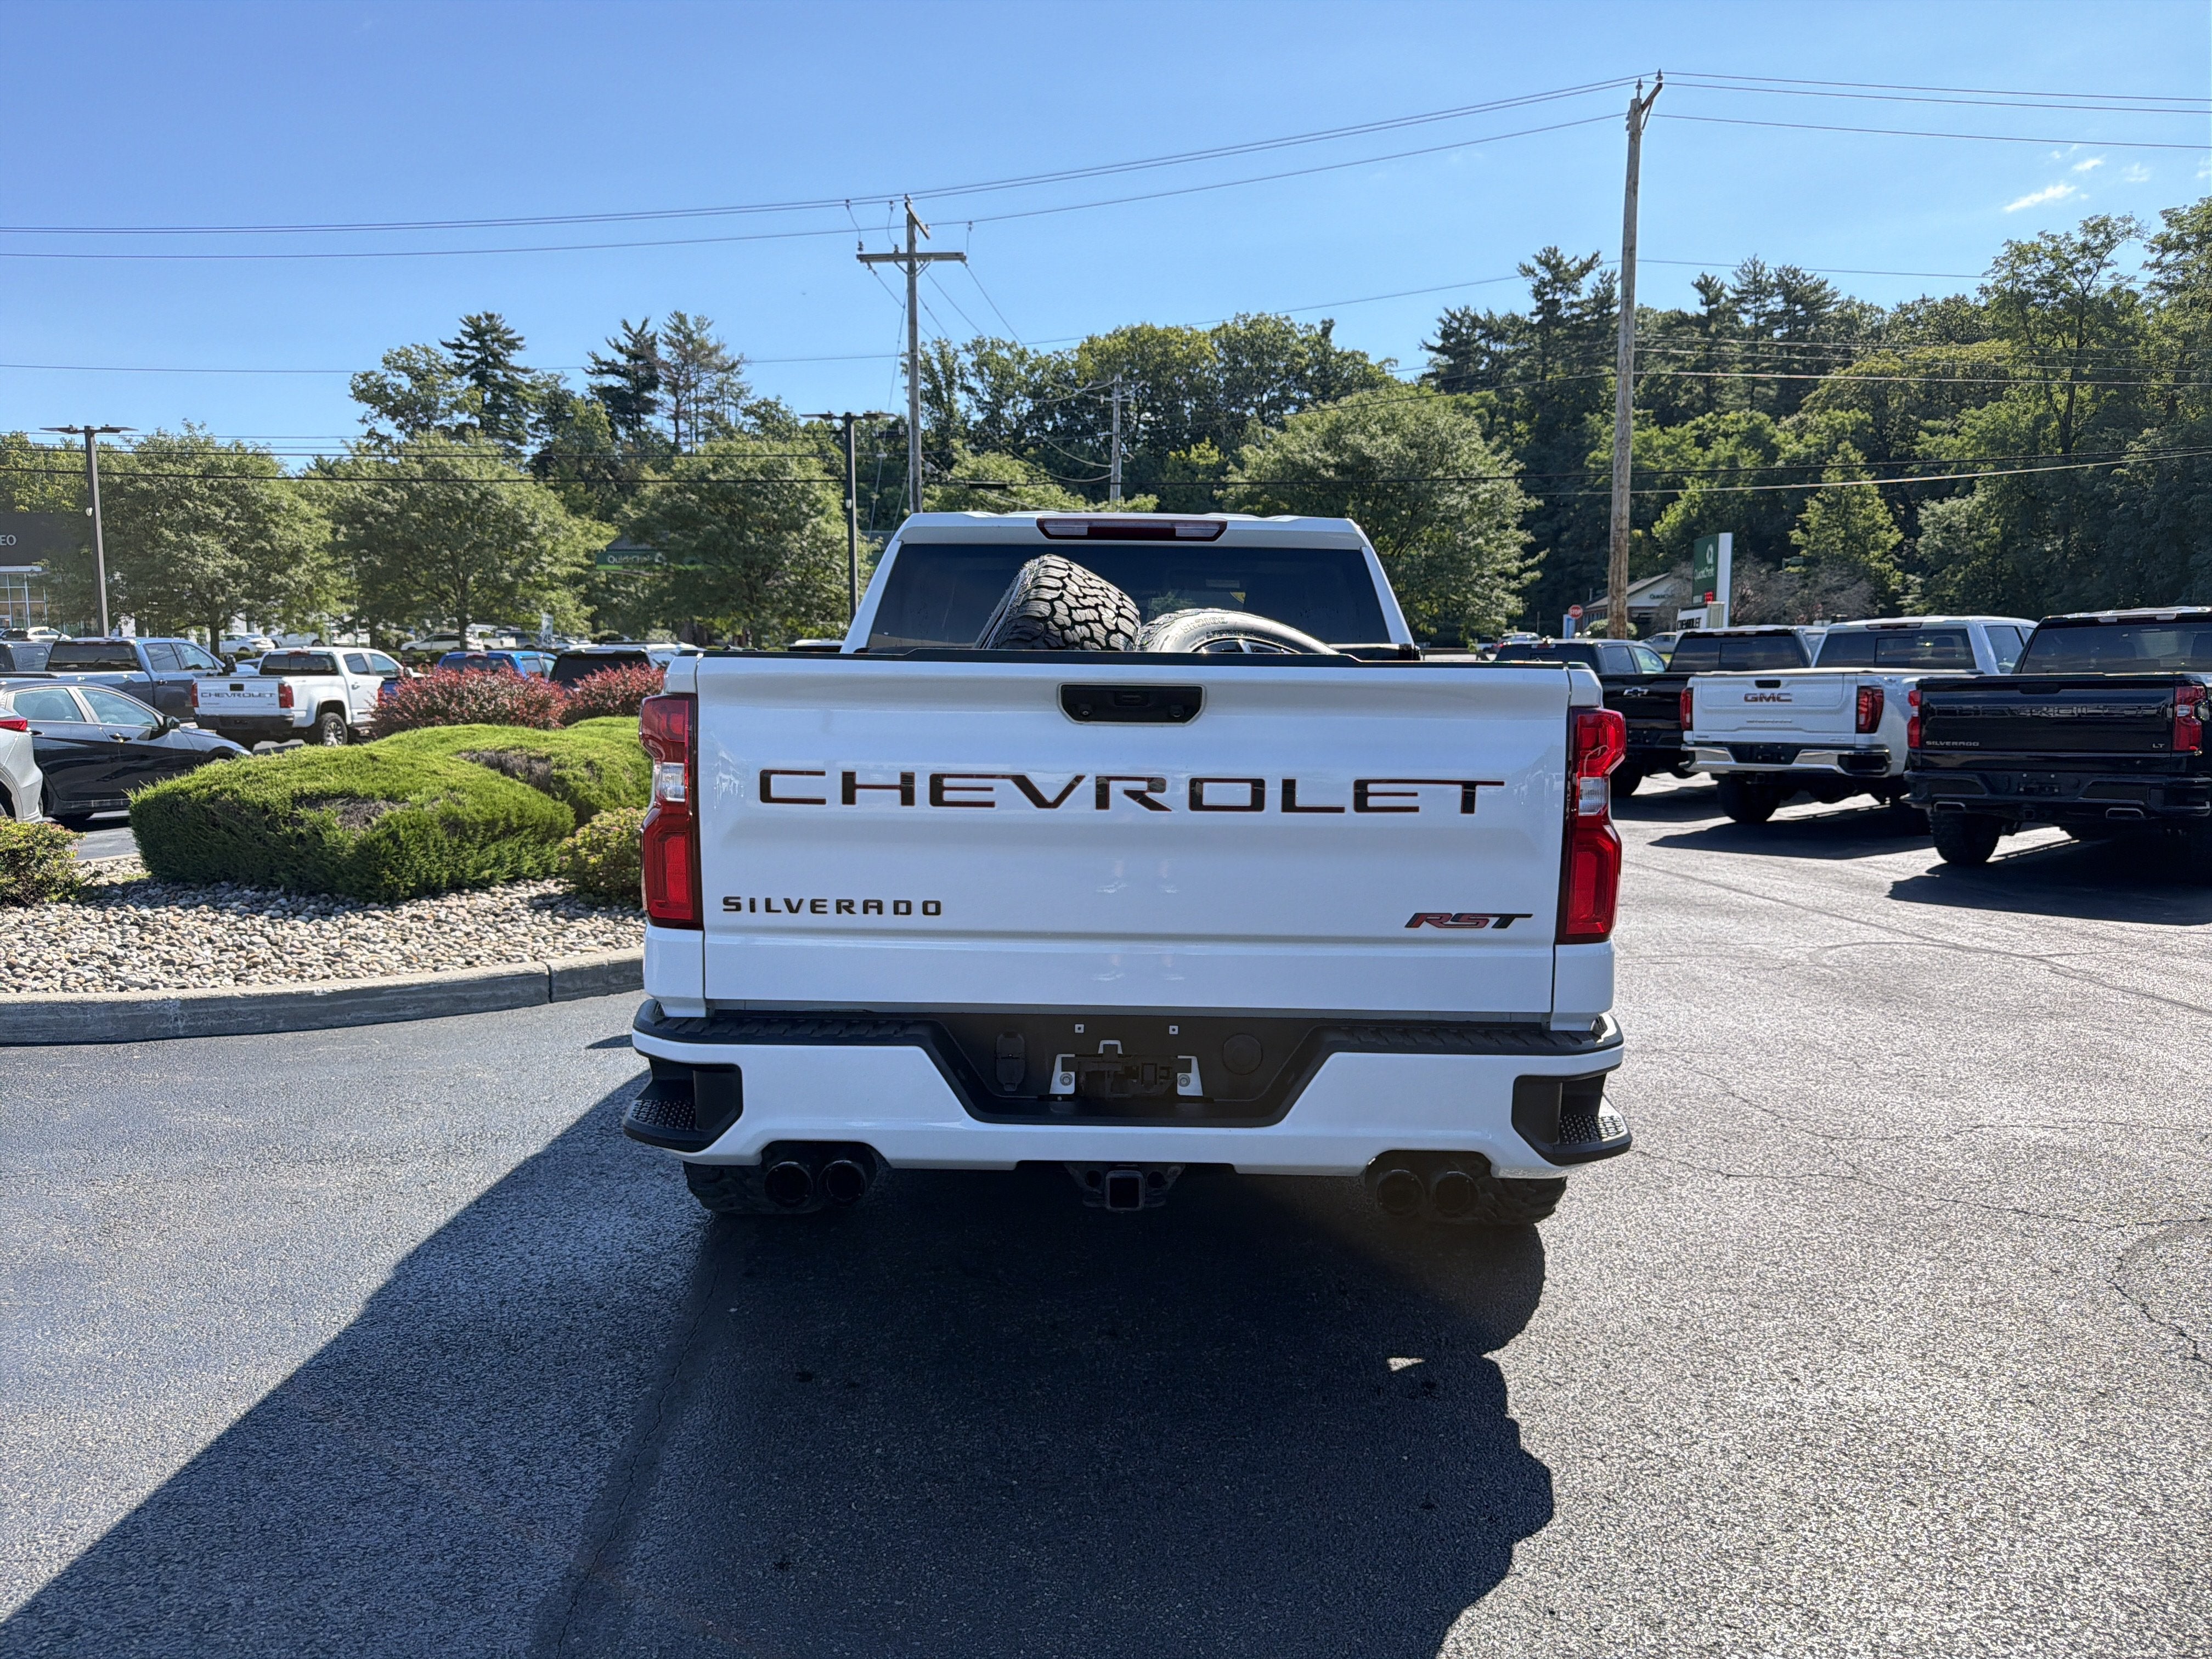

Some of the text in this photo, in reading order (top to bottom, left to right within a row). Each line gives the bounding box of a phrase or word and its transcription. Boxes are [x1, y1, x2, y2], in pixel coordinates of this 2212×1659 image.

[1743, 692, 1792, 703] GMC
[759, 768, 1505, 815] CHEVROLET
[722, 896, 941, 916] SILVERADO
[1404, 912, 1533, 929] RST
